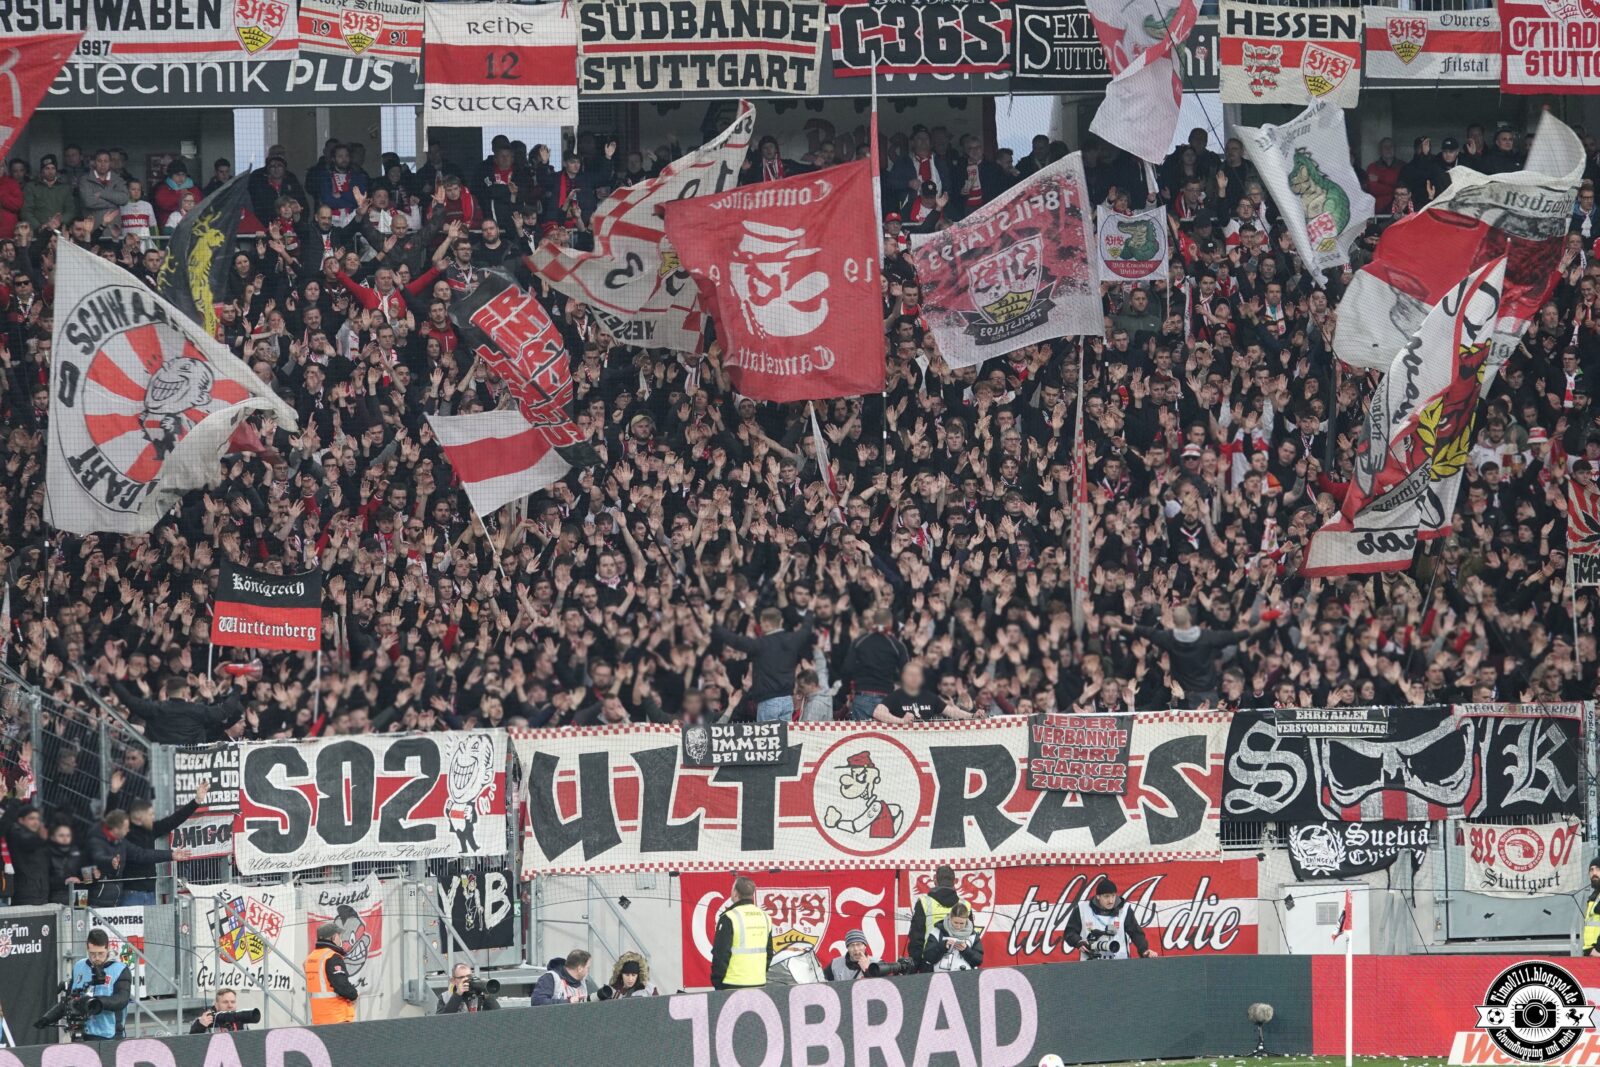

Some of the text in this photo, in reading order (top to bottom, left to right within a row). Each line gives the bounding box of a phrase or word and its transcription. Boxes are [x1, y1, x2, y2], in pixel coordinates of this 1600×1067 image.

[311, 20, 331, 35] 19
[580, 0, 820, 43] SÜDBANDE
[1225, 9, 1357, 39] HESSEN
[1440, 14, 1491, 28] Oberes
[389, 31, 408, 45] 91
[1513, 20, 1600, 48] 0711 AD
[284, 58, 395, 92] PLUS
[483, 52, 521, 80] 12
[582, 54, 816, 91] STUTTGART
[1439, 56, 1489, 74] Filstal
[232, 572, 305, 597] Königreich
[218, 616, 317, 642] Württemberg
[1044, 714, 1117, 730] JEDER
[1330, 710, 1369, 720] ALLEN
[711, 723, 781, 738] DU BIST
[1032, 725, 1128, 748] VERBANNTE
[1277, 723, 1386, 734] VERSTORBENEN ULTRAS
[712, 736, 781, 752] IMMER
[1041, 744, 1120, 762] KEHRT
[175, 752, 212, 770] GEGEN
[712, 750, 782, 763] BEI UNS!
[245, 737, 440, 854] S02
[1345, 822, 1429, 846] Suebia
[1480, 867, 1560, 895] Stuttgart
[318, 884, 371, 906] Leintal
[1163, 876, 1241, 951] die
[196, 965, 291, 989] Gundelsheim
